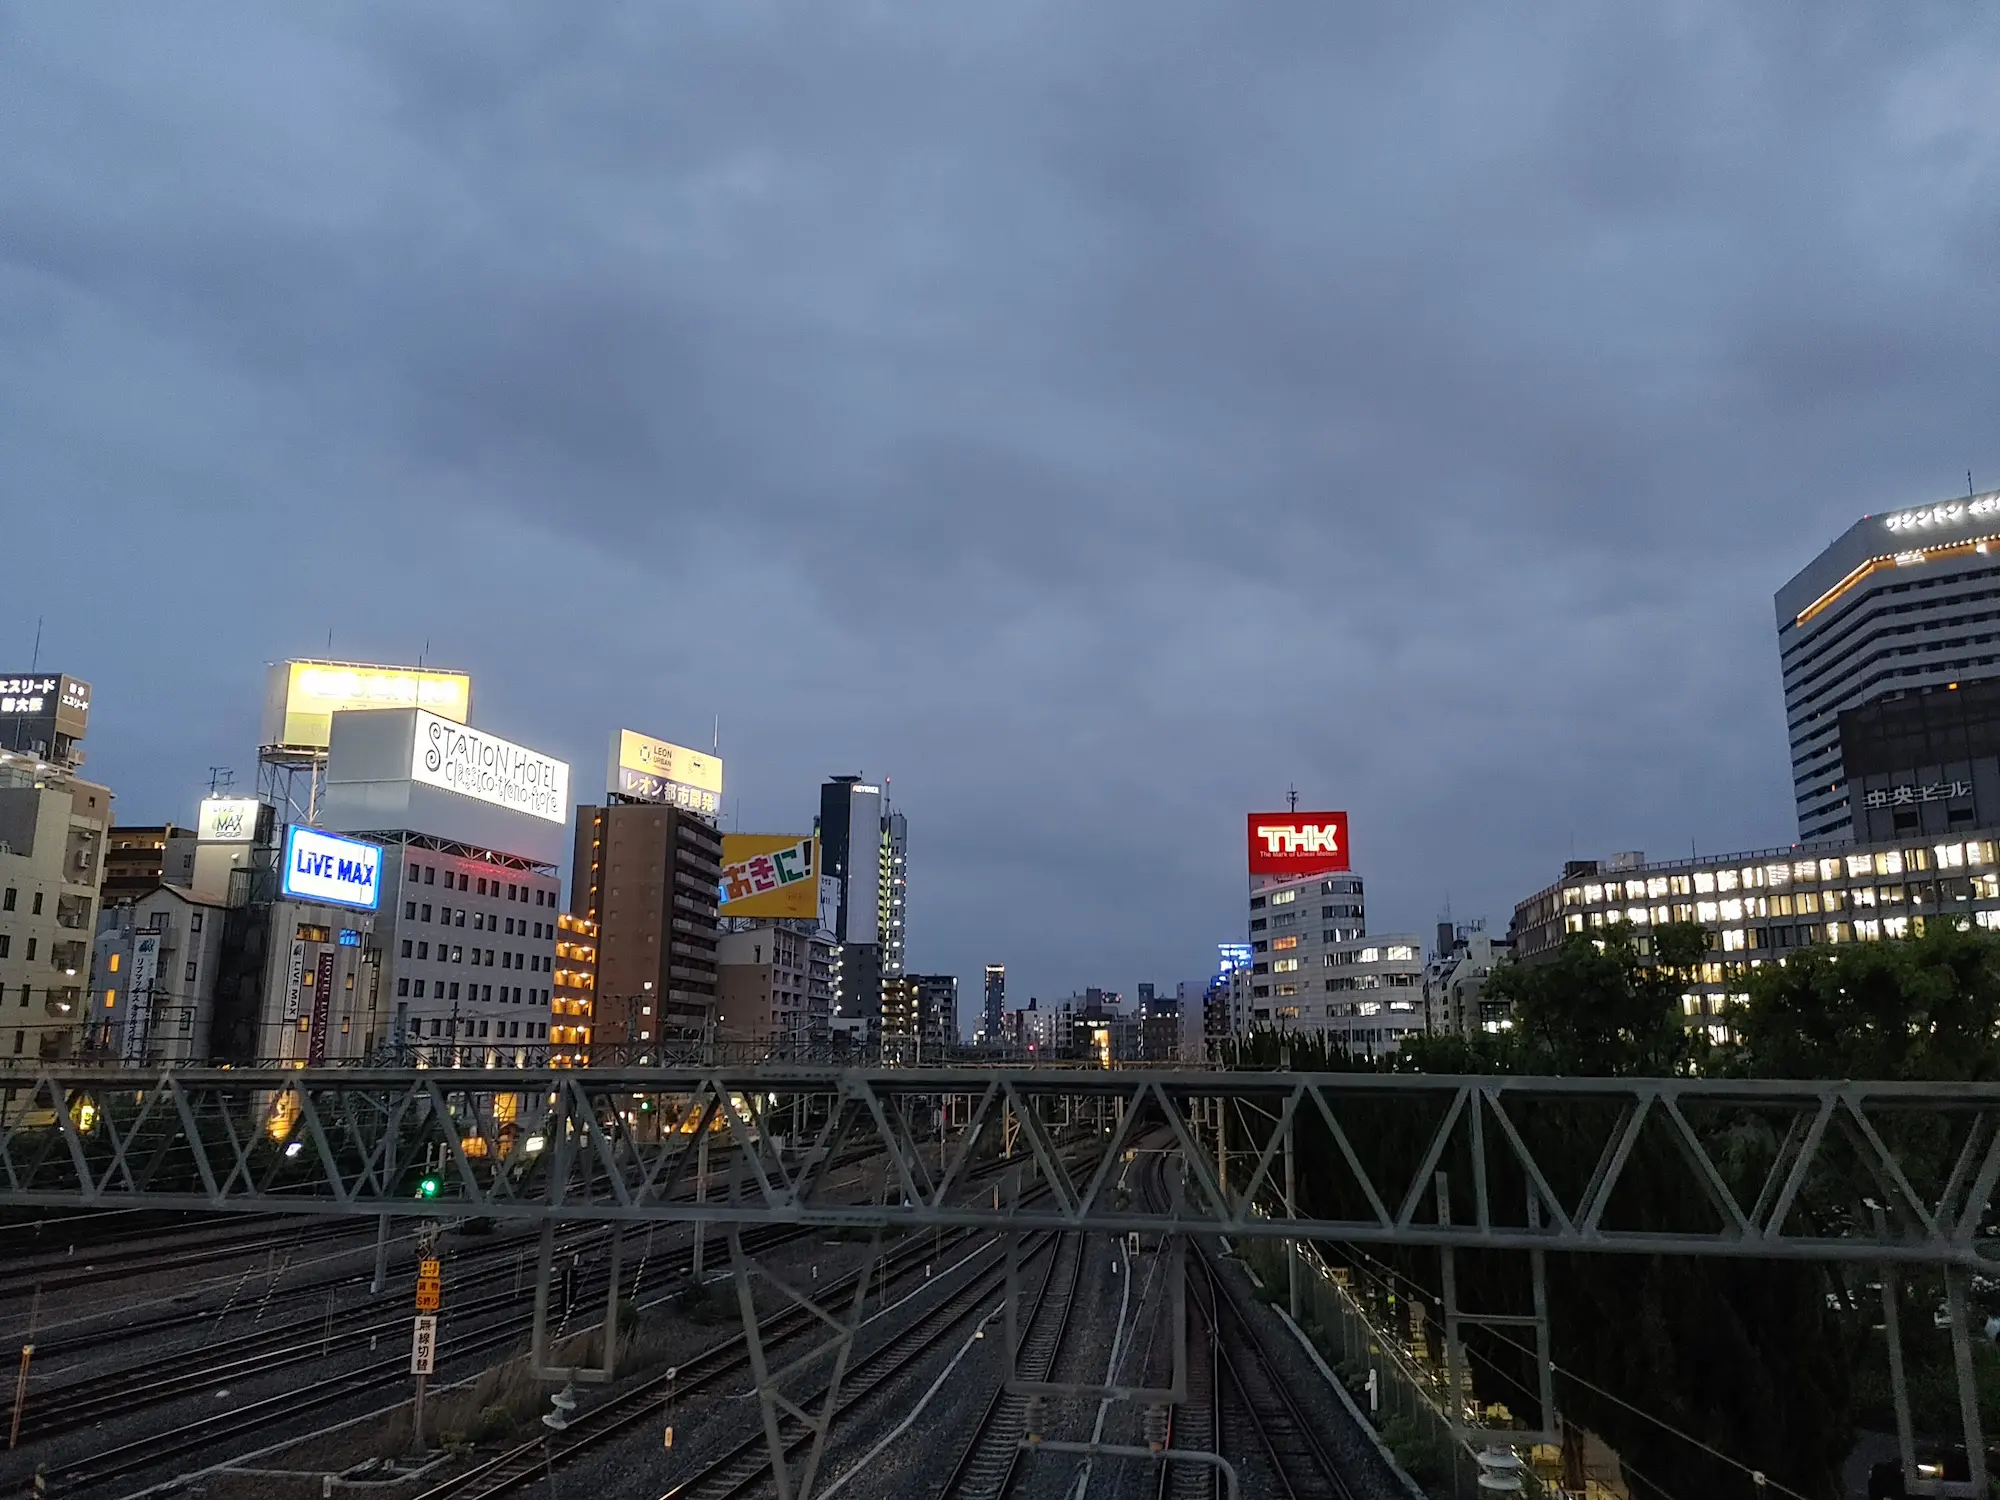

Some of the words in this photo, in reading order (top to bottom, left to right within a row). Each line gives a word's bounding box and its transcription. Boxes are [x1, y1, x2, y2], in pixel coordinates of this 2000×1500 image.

[654, 745, 672, 759] LEON
[513, 751, 557, 793] HOTEL
[627, 772, 714, 811] レオン都市開発
[1867, 781, 1968, 808] 中央ビル
[216, 814, 243, 831] MAX
[1257, 825, 1338, 852] THK
[337, 858, 374, 887] MAX
[292, 961, 302, 987] LIVE
[322, 956, 333, 996] HOTEL
[289, 989, 299, 1015] MAX
[315, 1001, 328, 1058] LIVEMAX
[416, 1319, 431, 1371] 無線切替
